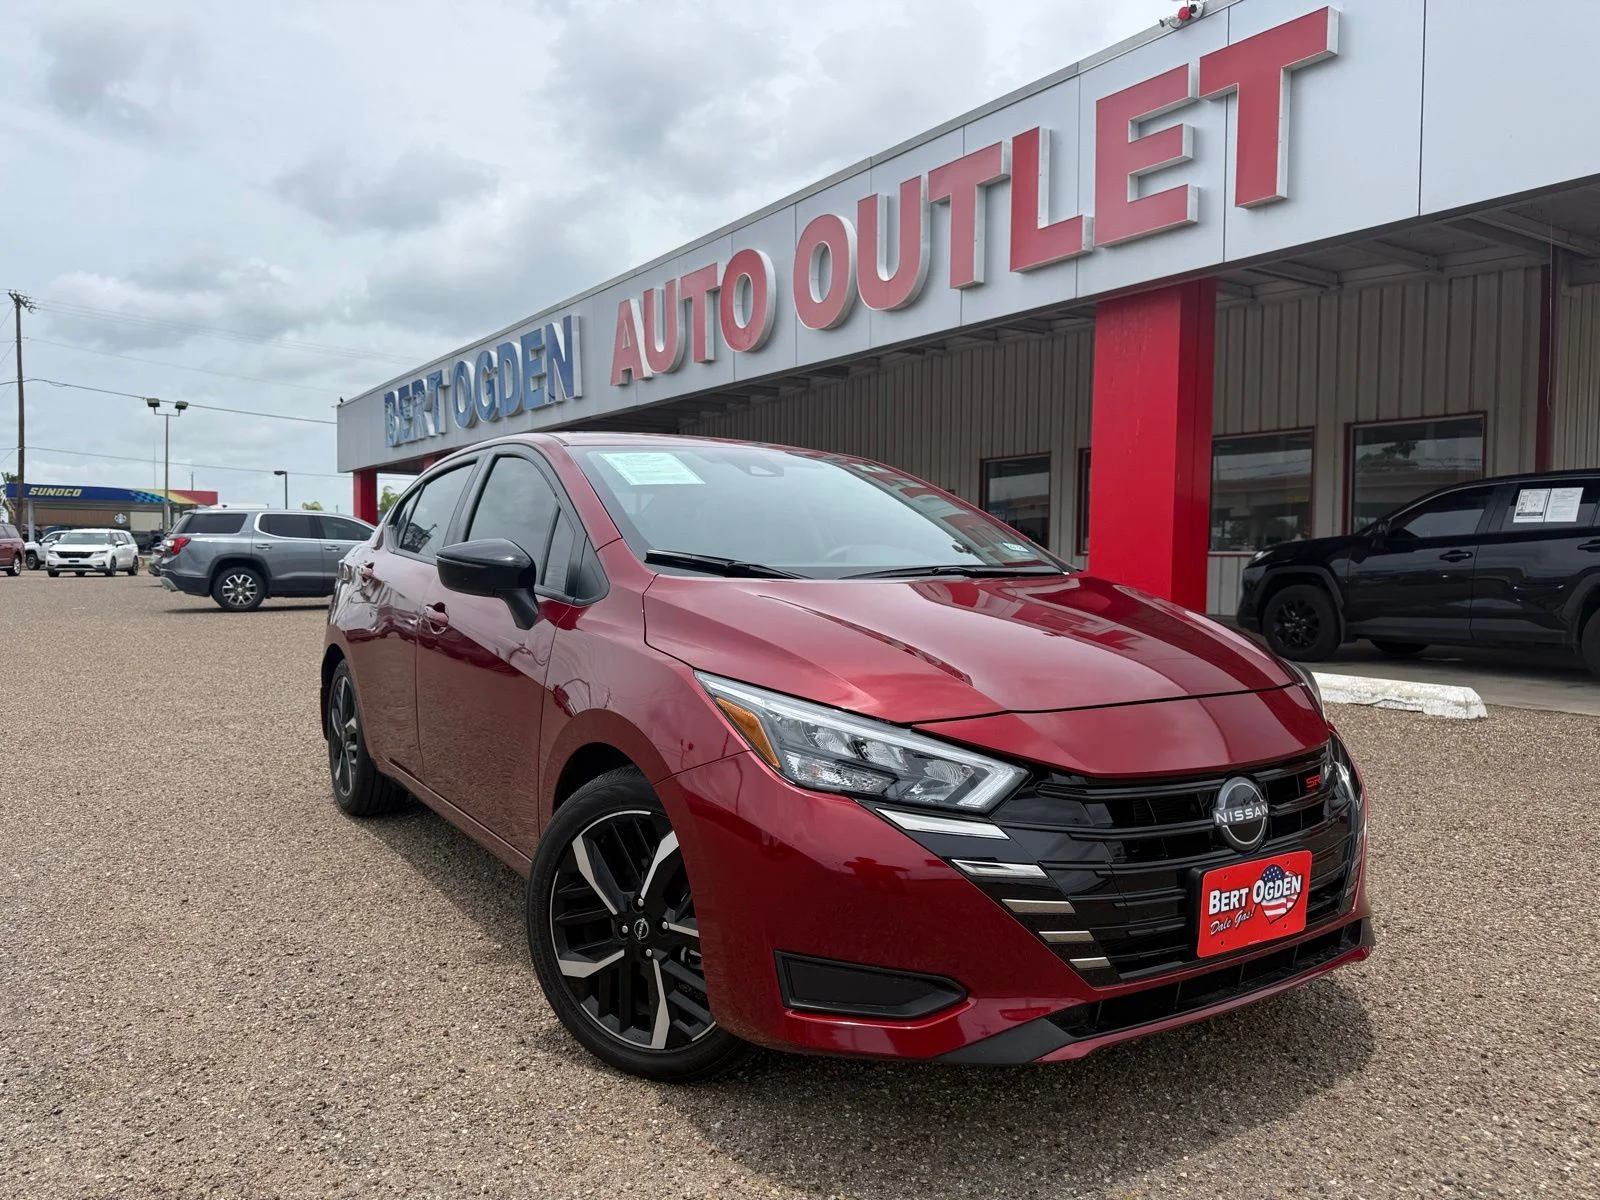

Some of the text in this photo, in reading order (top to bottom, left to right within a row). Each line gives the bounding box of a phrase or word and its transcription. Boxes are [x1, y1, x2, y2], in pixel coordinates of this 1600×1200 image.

[384, 6, 1341, 448] BERT OGDEN AUTO OUTLET
[28, 487, 82, 497] SUNOCO
[1306, 775, 1321, 788] SR
[1216, 805, 1269, 823] NISSAN
[1208, 874, 1302, 915] BERT OGDEN
[1210, 904, 1256, 935] Dale Gas!
